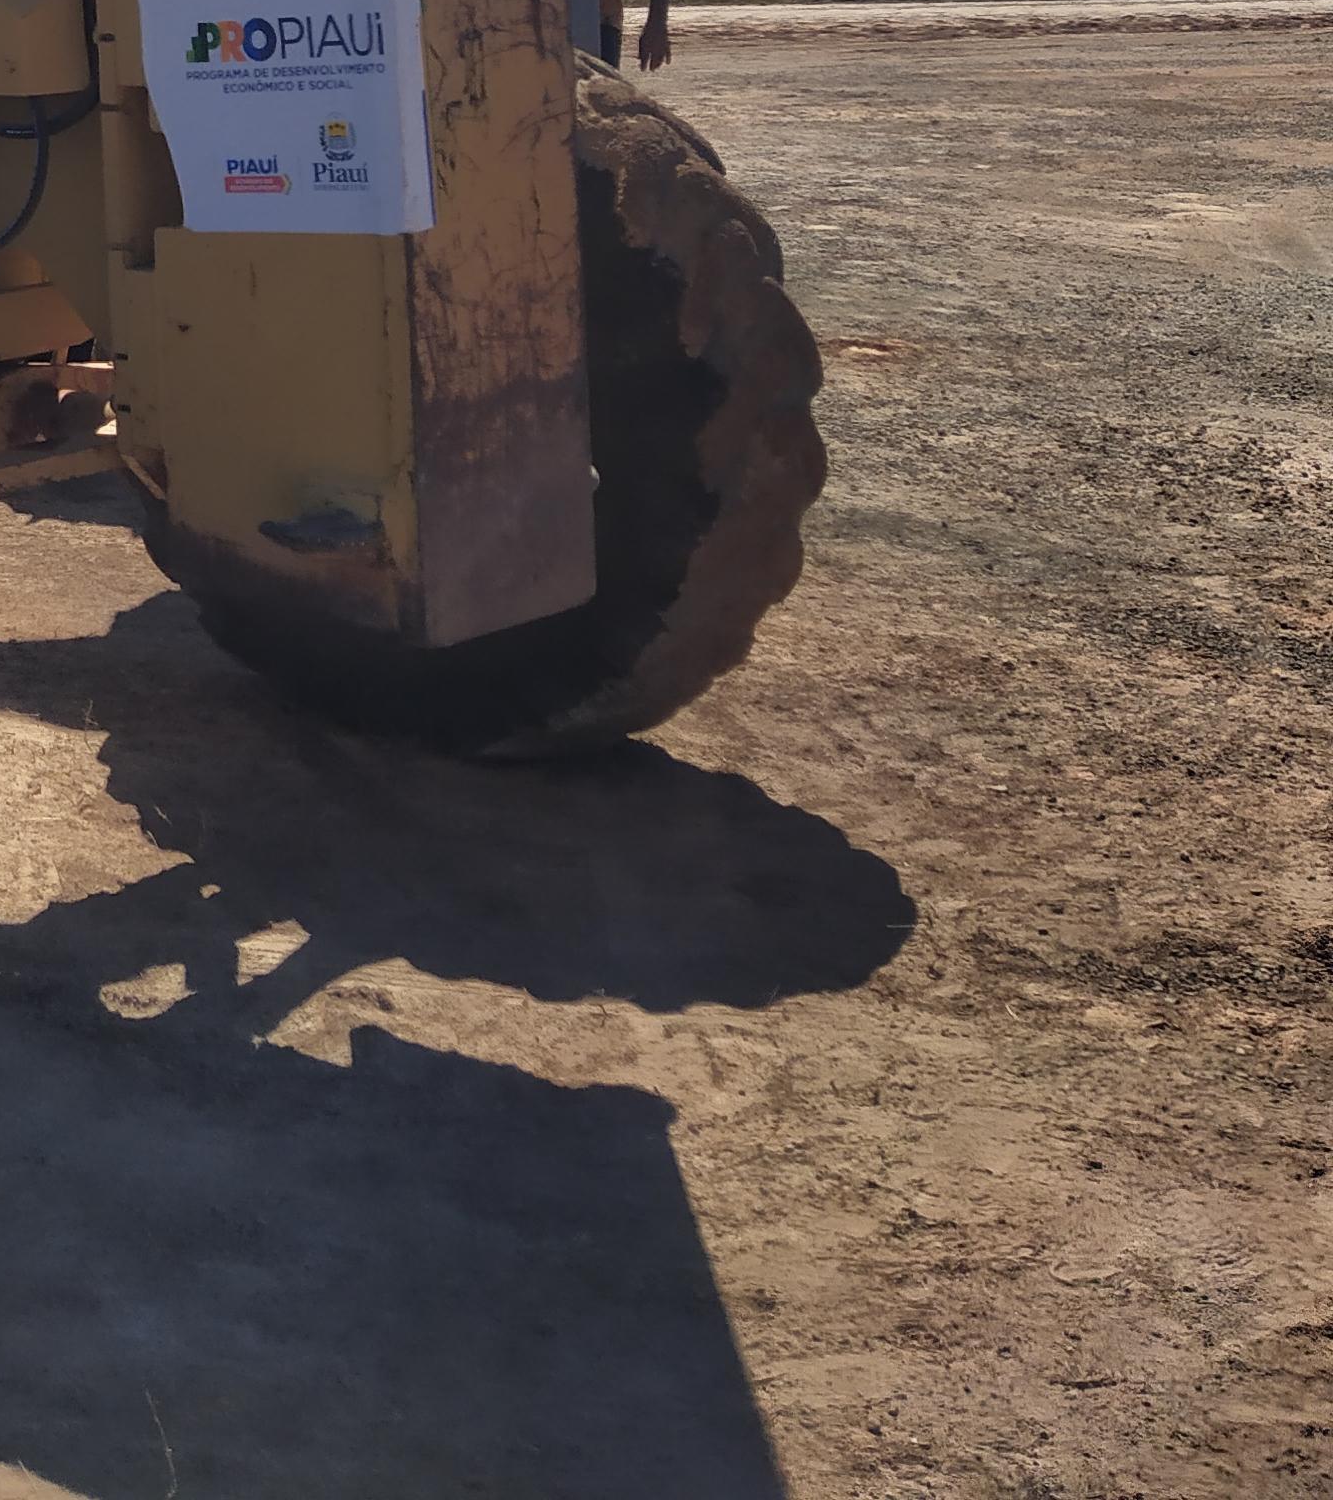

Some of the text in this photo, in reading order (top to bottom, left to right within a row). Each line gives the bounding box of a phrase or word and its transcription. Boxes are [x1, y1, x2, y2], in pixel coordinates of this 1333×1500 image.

[186, 63, 385, 81] PROGRAMA DE DESENVOLVIMENTO
[223, 79, 353, 94] ECONÔMICO E SOCIAL
[227, 155, 279, 174] PIAUÍ
[314, 162, 372, 184] Piauí
